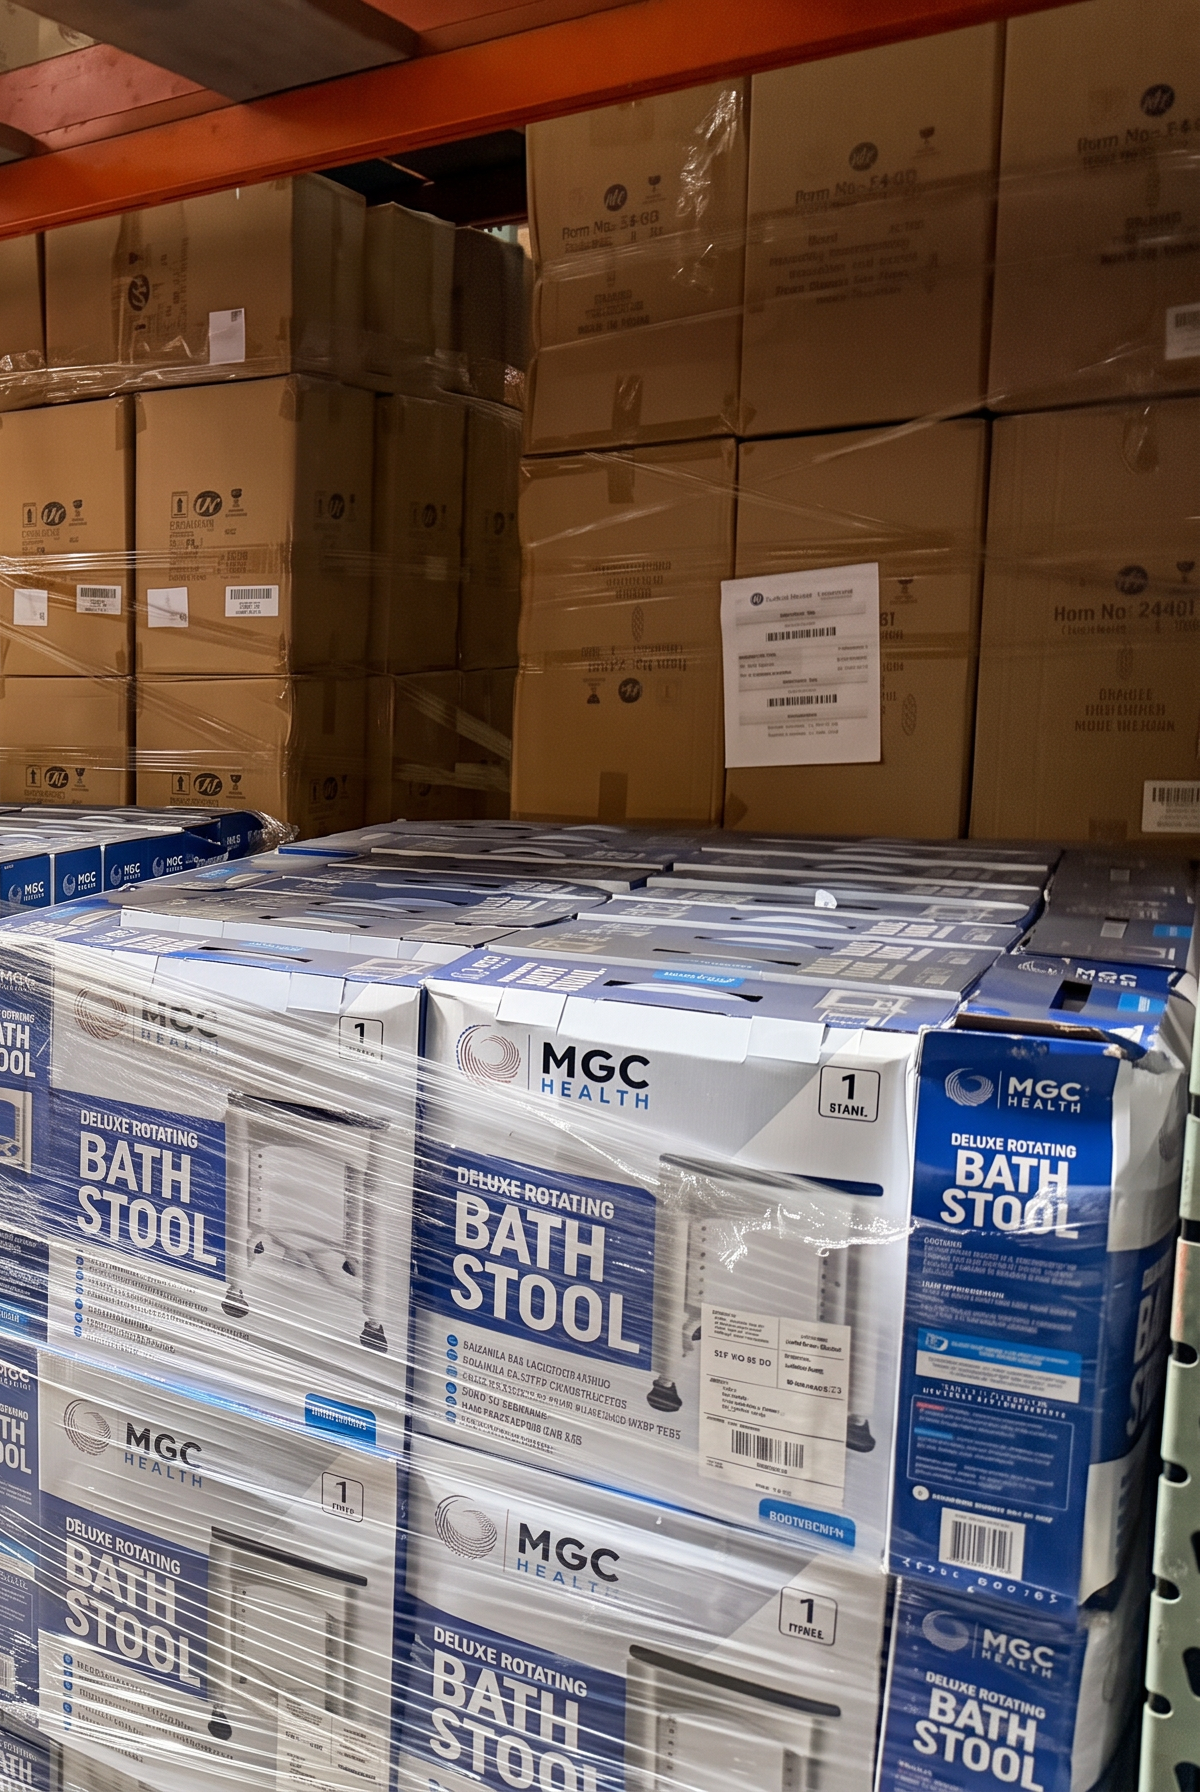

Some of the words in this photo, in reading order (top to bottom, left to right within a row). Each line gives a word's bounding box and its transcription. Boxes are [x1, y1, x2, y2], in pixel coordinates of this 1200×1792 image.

[354, 1022, 365, 1044] 1
[541, 1041, 651, 1091] MGC
[842, 1073, 855, 1100] 1
[1007, 1077, 1082, 1102] MGC
[541, 1077, 650, 1111] HEALTH
[1007, 1096, 1081, 1114] HEALTH
[80, 1110, 130, 1134] DELUXE
[132, 1120, 198, 1148] ROTATING
[951, 1133, 1004, 1151] DELUXE
[1007, 1139, 1077, 1158] ROTATING
[79, 1131, 191, 1204] BATH
[955, 1149, 1069, 1199] BATH
[457, 1166, 520, 1198] DELUXE
[525, 1186, 615, 1220] ROTATING
[940, 1188, 1079, 1240] STOOL
[77, 1185, 218, 1267] STOOL
[455, 1190, 606, 1283] BATH
[450, 1254, 640, 1354] STOOL
[124, 1451, 202, 1489] HEALTH
[126, 1421, 203, 1469] MGC
[336, 1481, 348, 1504] 1
[66, 1516, 114, 1553] DELUXE
[115, 1535, 181, 1575] ROTATING
[518, 1522, 621, 1583] MGC
[66, 1537, 177, 1626] BATH
[800, 1597, 814, 1624] 1
[65, 1589, 200, 1687] STOOL
[433, 1626, 497, 1666] DELUXE
[501, 1651, 588, 1698] ROTATING
[983, 1628, 1056, 1668] MGC
[981, 1649, 1052, 1680] HEALTH
[432, 1649, 579, 1752] BATH
[926, 1671, 976, 1697] DELUXE
[978, 1687, 1046, 1720] ROTATING
[928, 1687, 1037, 1754] BATH
[912, 1719, 1044, 1792] STOOL
